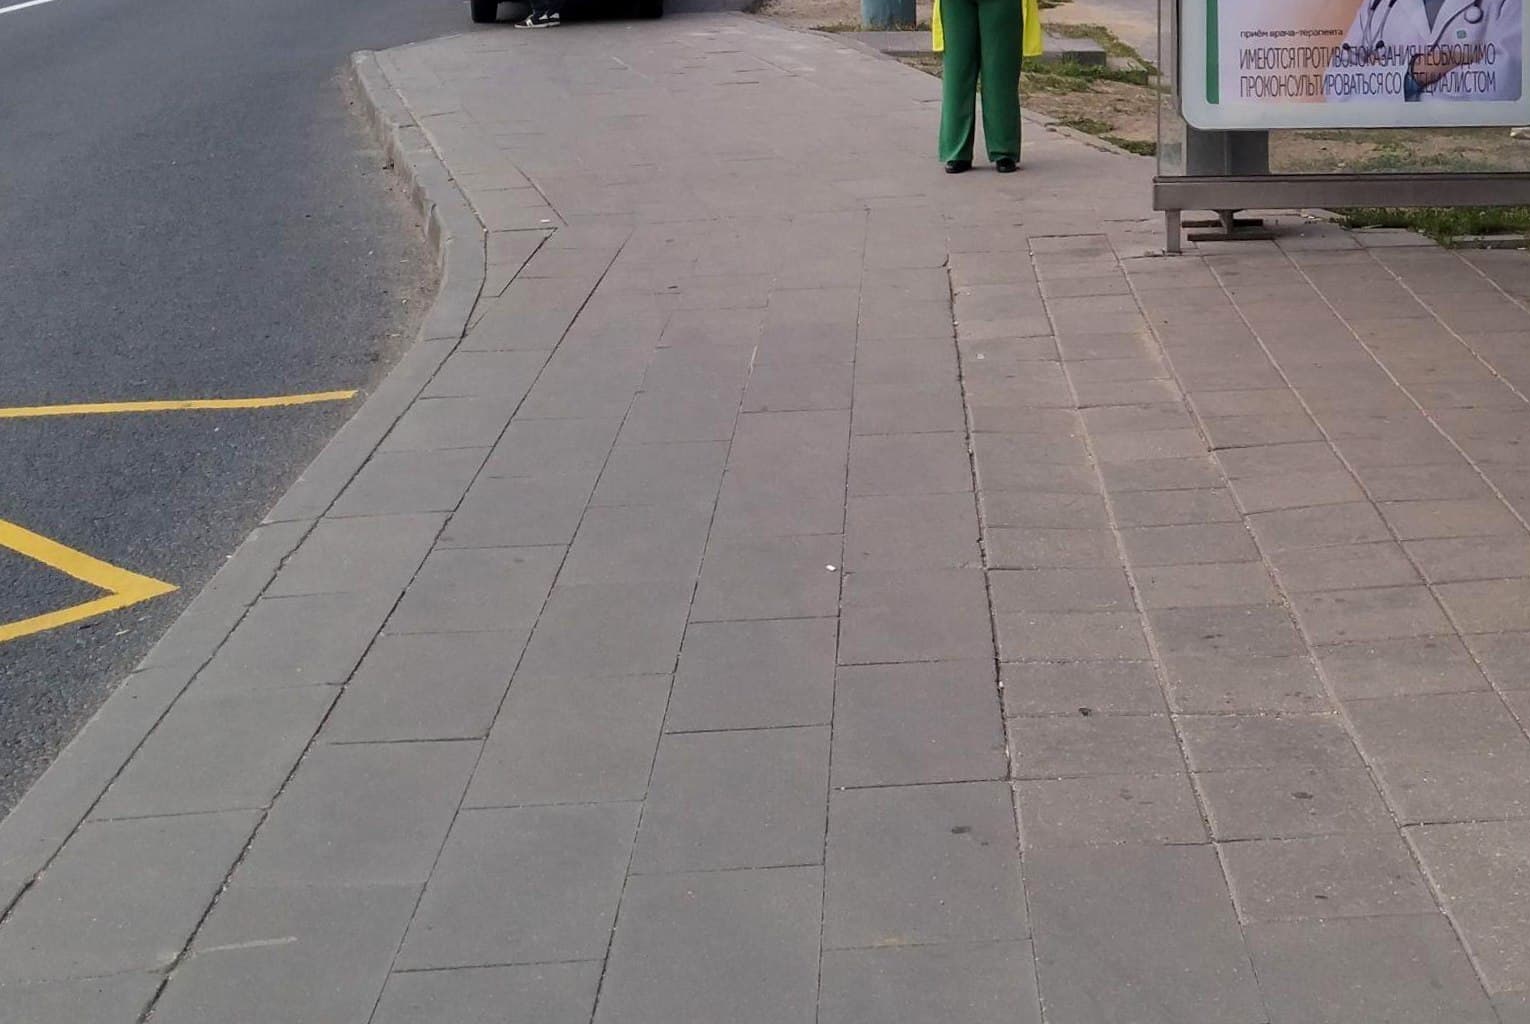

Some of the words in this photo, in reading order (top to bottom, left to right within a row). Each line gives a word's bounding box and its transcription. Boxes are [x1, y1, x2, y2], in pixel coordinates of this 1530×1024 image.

[1239, 47, 1296, 70] ИМЕЮТСЯ
[1239, 72, 1384, 97] ПРОКОНСУЛЬТИРОВАТЬСЯ
[1384, 71, 1402, 95] СО
